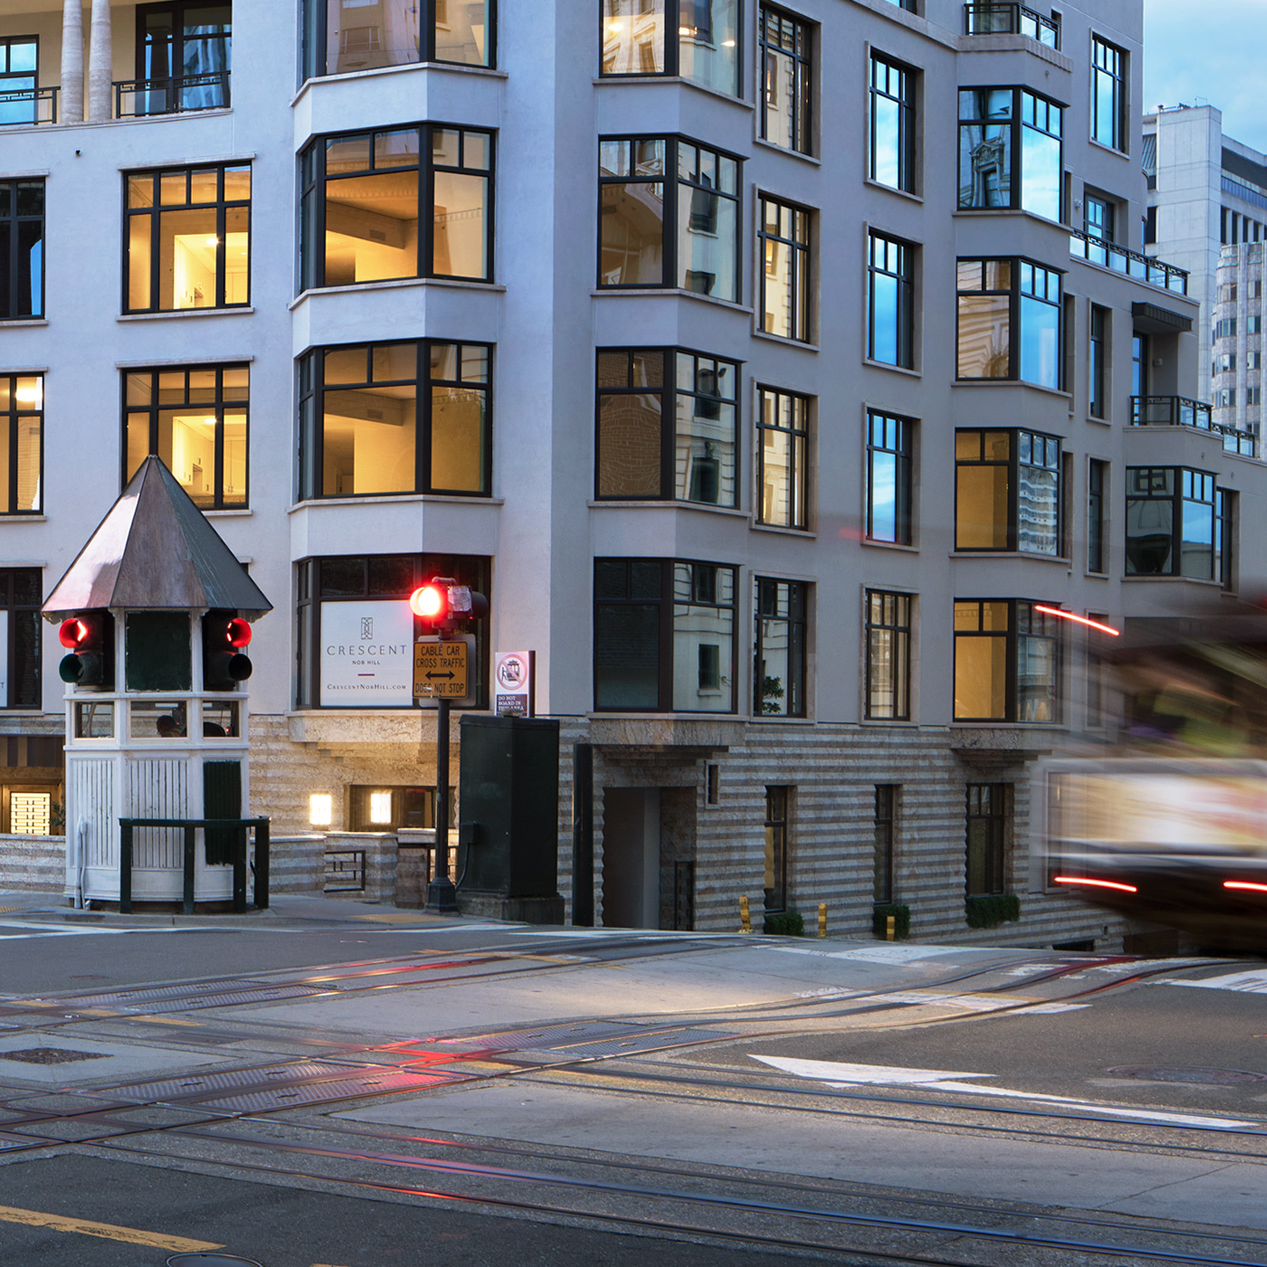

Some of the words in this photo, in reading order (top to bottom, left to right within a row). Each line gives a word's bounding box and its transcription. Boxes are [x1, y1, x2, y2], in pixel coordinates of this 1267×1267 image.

[327, 645, 406, 655] CRESCENT
[421, 646, 442, 655] CABLE
[446, 646, 460, 655] CAR
[416, 658, 437, 667] CROSS
[440, 658, 465, 668] TRAFFIC
[415, 683, 432, 693] DOES
[435, 683, 446, 693] NOT
[449, 683, 464, 693] STOP
